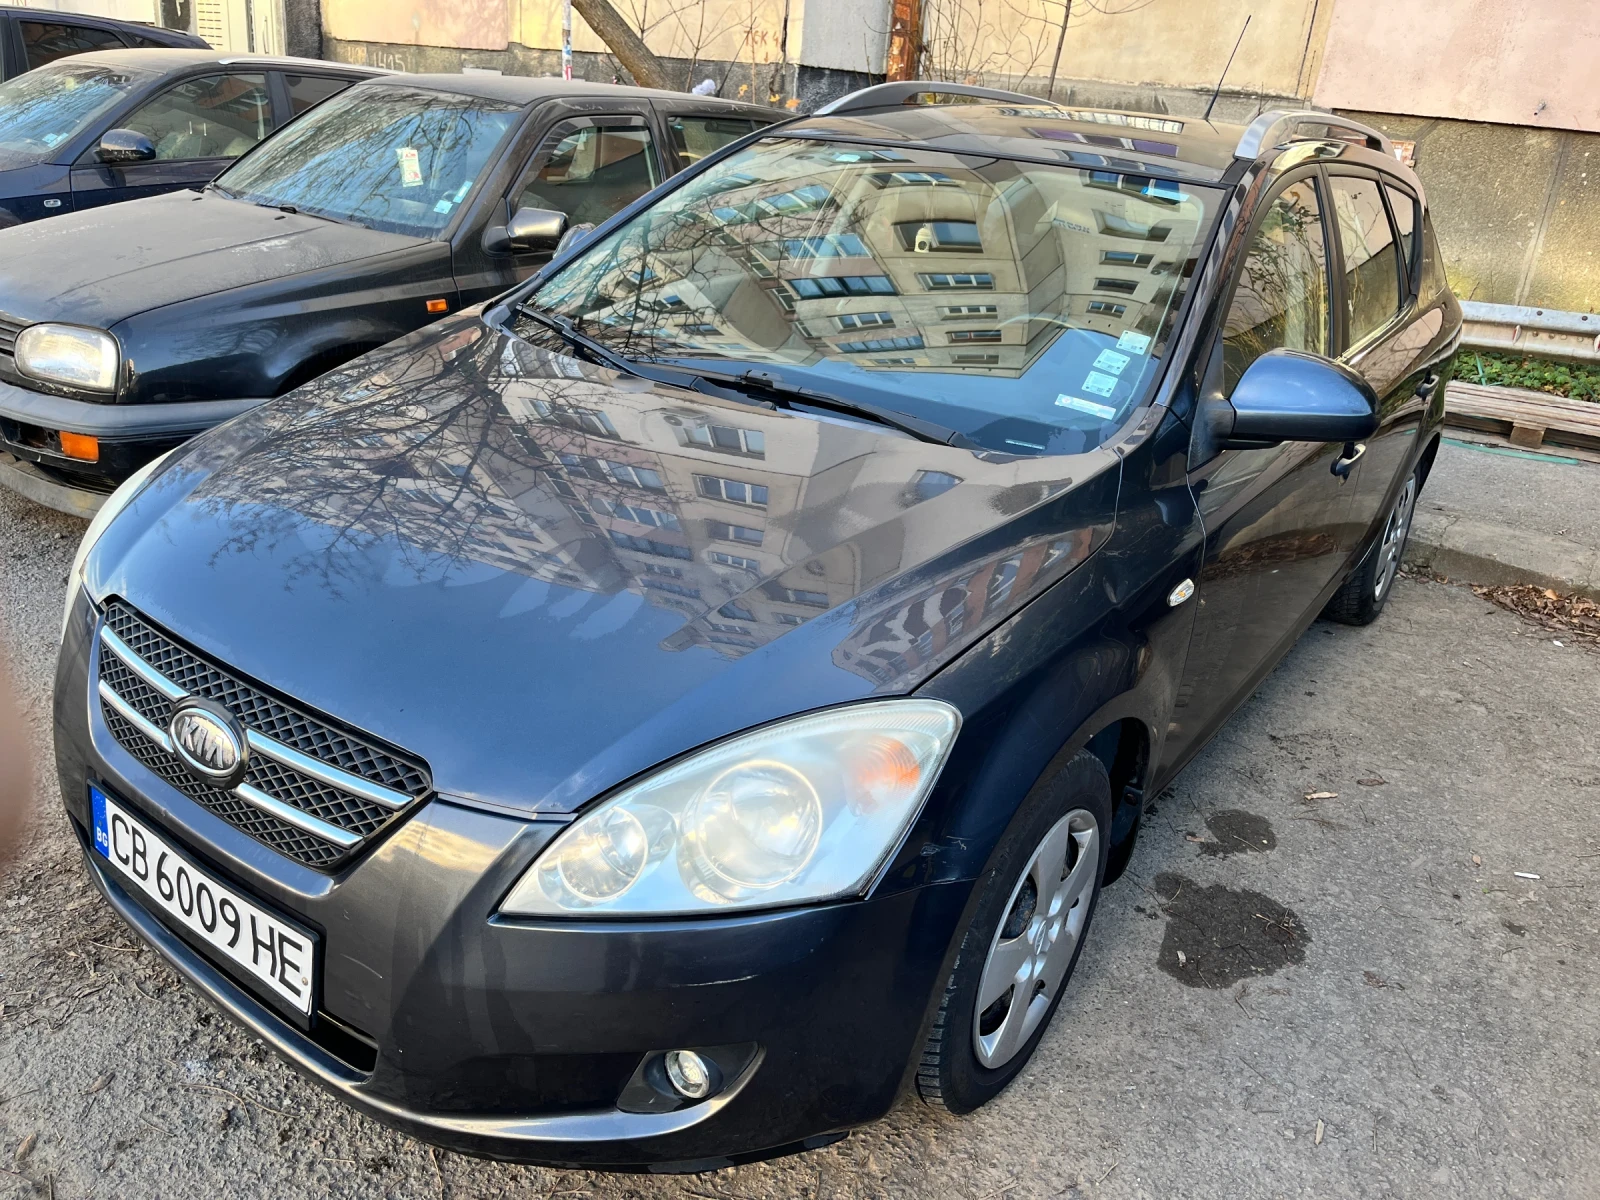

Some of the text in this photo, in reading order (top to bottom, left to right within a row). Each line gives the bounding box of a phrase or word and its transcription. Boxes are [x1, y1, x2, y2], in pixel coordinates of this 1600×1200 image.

[180, 716, 224, 769] KIA
[96, 827, 108, 847] BG
[112, 813, 303, 998] CB 6009 HE
